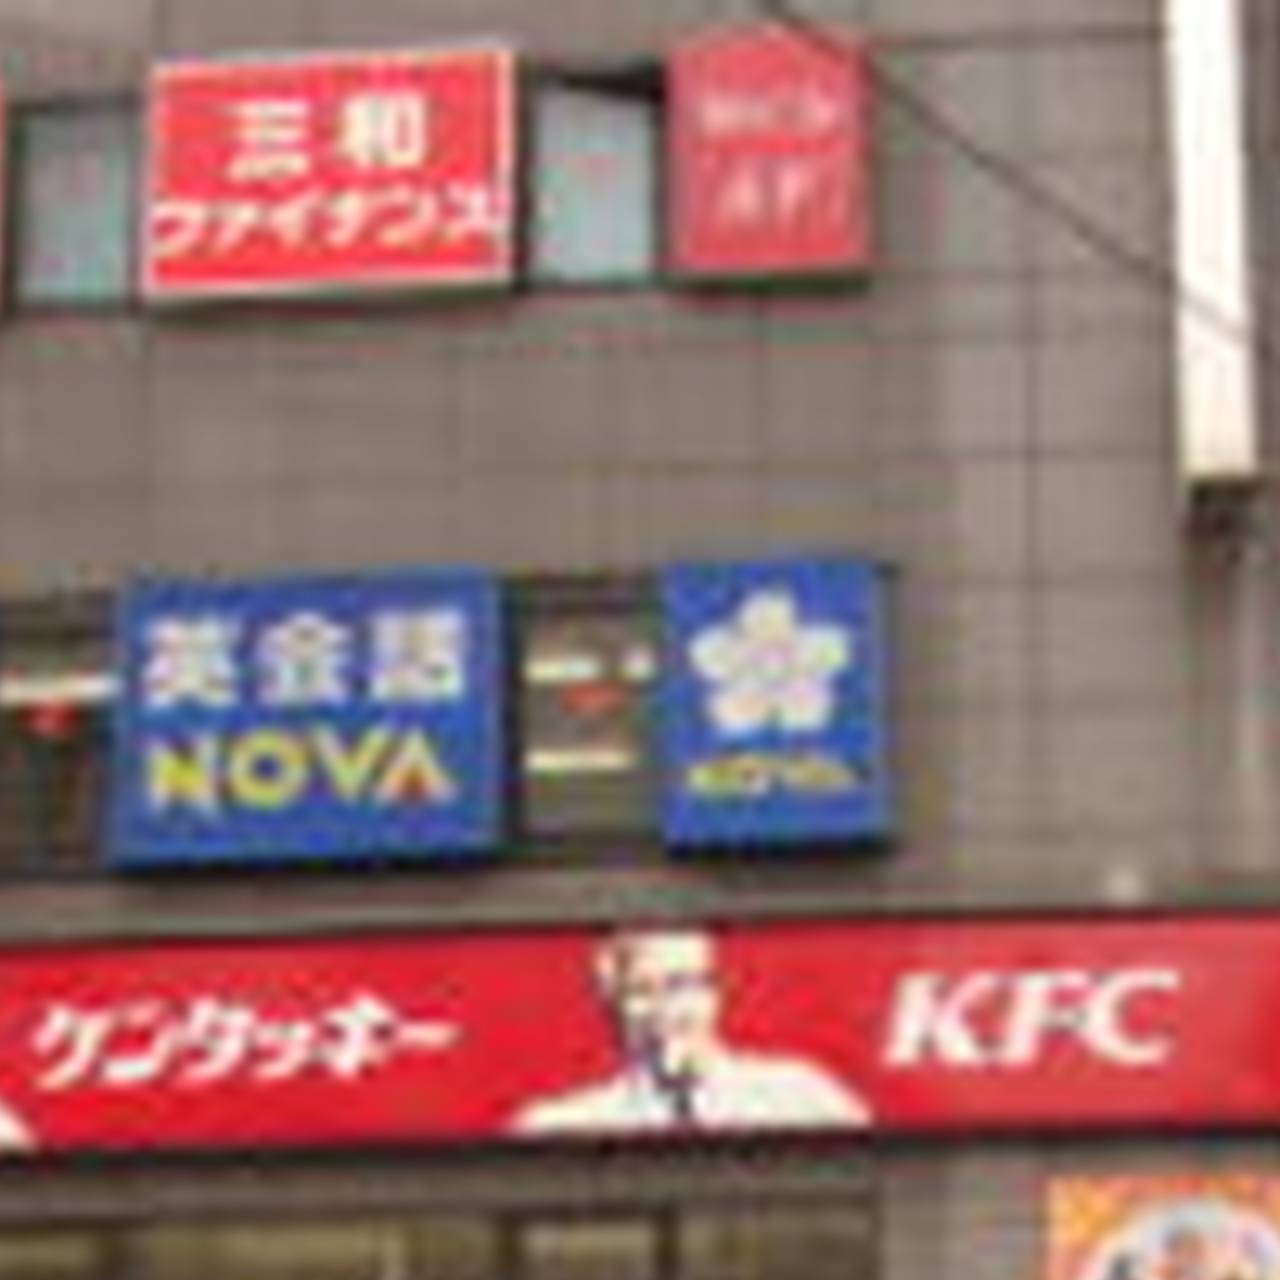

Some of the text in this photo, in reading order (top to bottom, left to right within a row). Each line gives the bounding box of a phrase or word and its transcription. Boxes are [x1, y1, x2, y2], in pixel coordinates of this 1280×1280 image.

[228, 90, 427, 182] 三和
[152, 180, 503, 256] ファイナンス
[141, 608, 468, 710] 英会話
[144, 726, 458, 814] NOVA
[31, 990, 461, 1093] ケンタッキー
[881, 967, 1181, 1068] KFC
